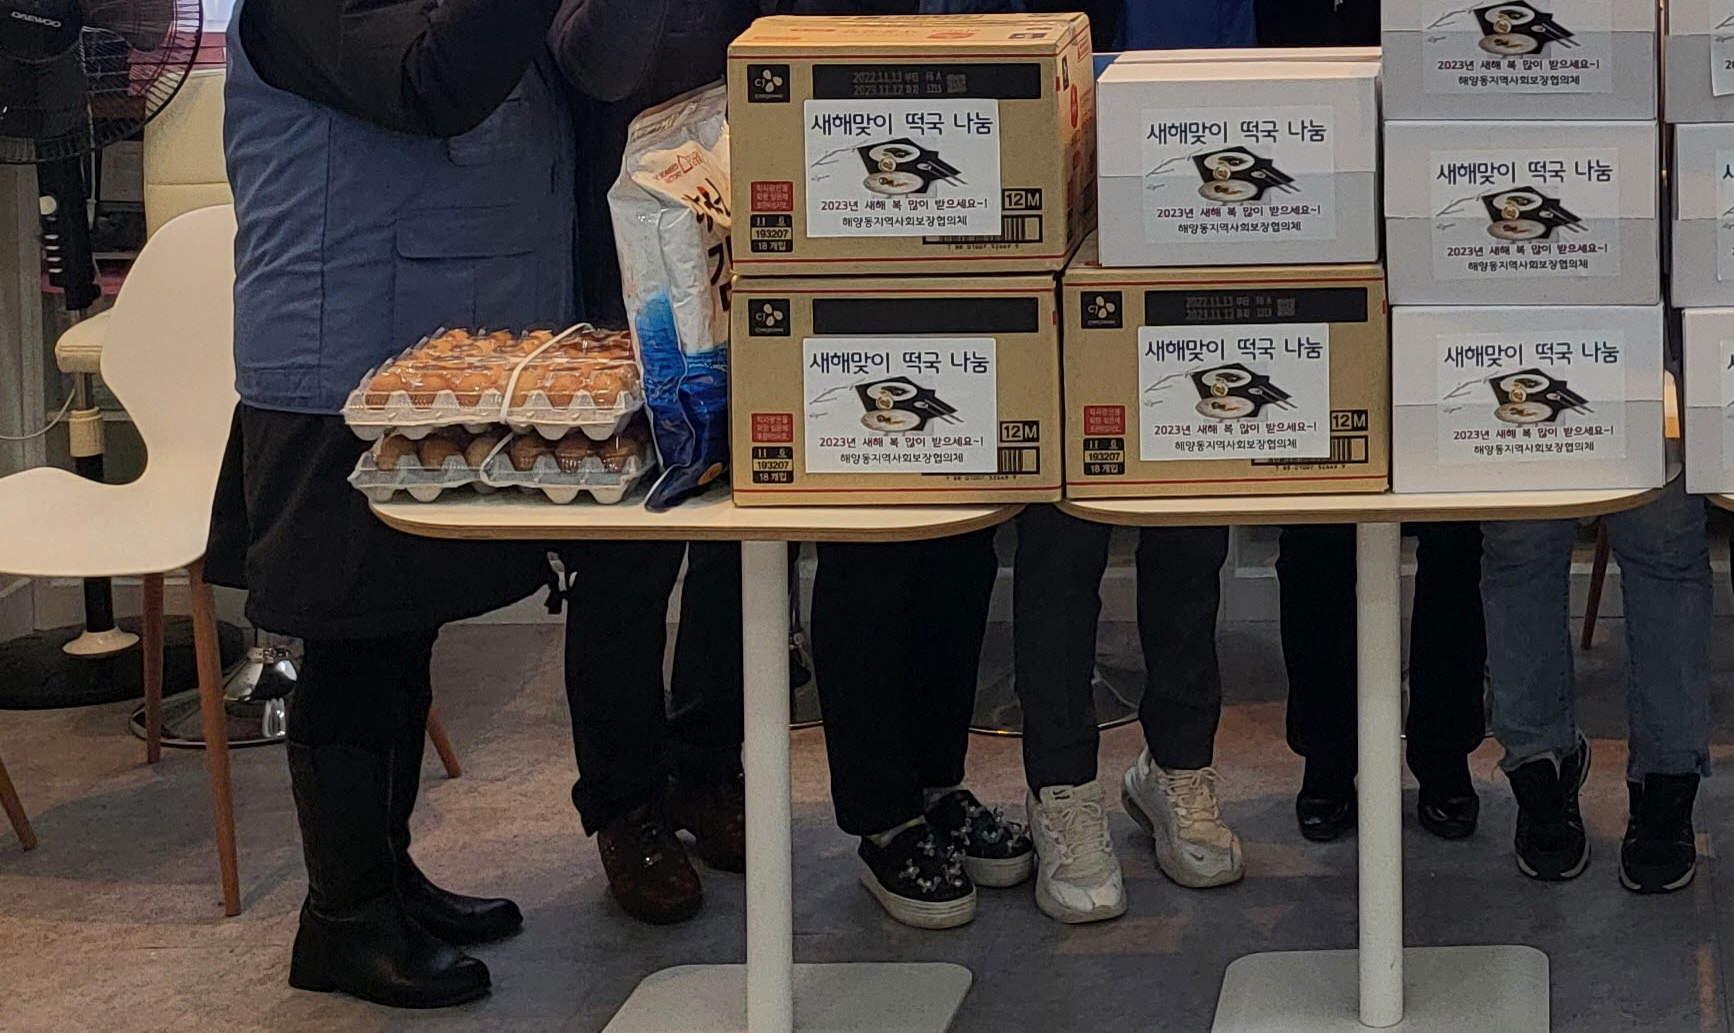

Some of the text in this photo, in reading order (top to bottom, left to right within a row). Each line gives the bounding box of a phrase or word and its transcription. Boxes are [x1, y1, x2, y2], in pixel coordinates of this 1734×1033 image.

[10, 10, 62, 28] DAEWOO
[754, 78, 766, 89] CJ
[810, 111, 994, 137] 새해맞이 떡국 나눔
[1146, 120, 1327, 146] 새해맞이 떡국 나눔
[1436, 160, 1614, 186] 새해맞이 떡국 나눔
[821, 200, 859, 212] 2023년
[864, 200, 887, 211] 새해
[891, 198, 902, 212] 복
[906, 198, 929, 212] 많이
[1157, 208, 1195, 219] 2023년
[1200, 207, 1222, 218] 새해
[1226, 205, 1237, 218] 복
[1241, 205, 1264, 218] 많이
[842, 215, 967, 229] 해양동지역사회보장협의체
[1177, 221, 1301, 236] 해양동지역사회보장협의체
[755, 229, 788, 239] 193207
[755, 312, 766, 321] CJ
[1087, 304, 1099, 315] CJ
[1144, 336, 1324, 363] 새해맞이 떡국 나눔
[1443, 341, 1620, 369] 새해맞이 떡국 나눔
[809, 351, 990, 375] 새해맞이 떡국 나눔
[1154, 425, 1192, 436] 2023년
[1197, 424, 1219, 435] 새해
[1223, 422, 1234, 435] 복
[1238, 422, 1260, 435] 많이
[819, 437, 857, 449] 2023년
[862, 437, 884, 448] 새해
[888, 435, 899, 449] 복
[903, 435, 926, 449] 많이
[1174, 438, 1297, 453] 해양동지역사회보장협의체
[840, 452, 963, 465] 해양동지역사회보장협의체
[1088, 452, 1121, 462] 193207
[756, 460, 790, 470] 193207
